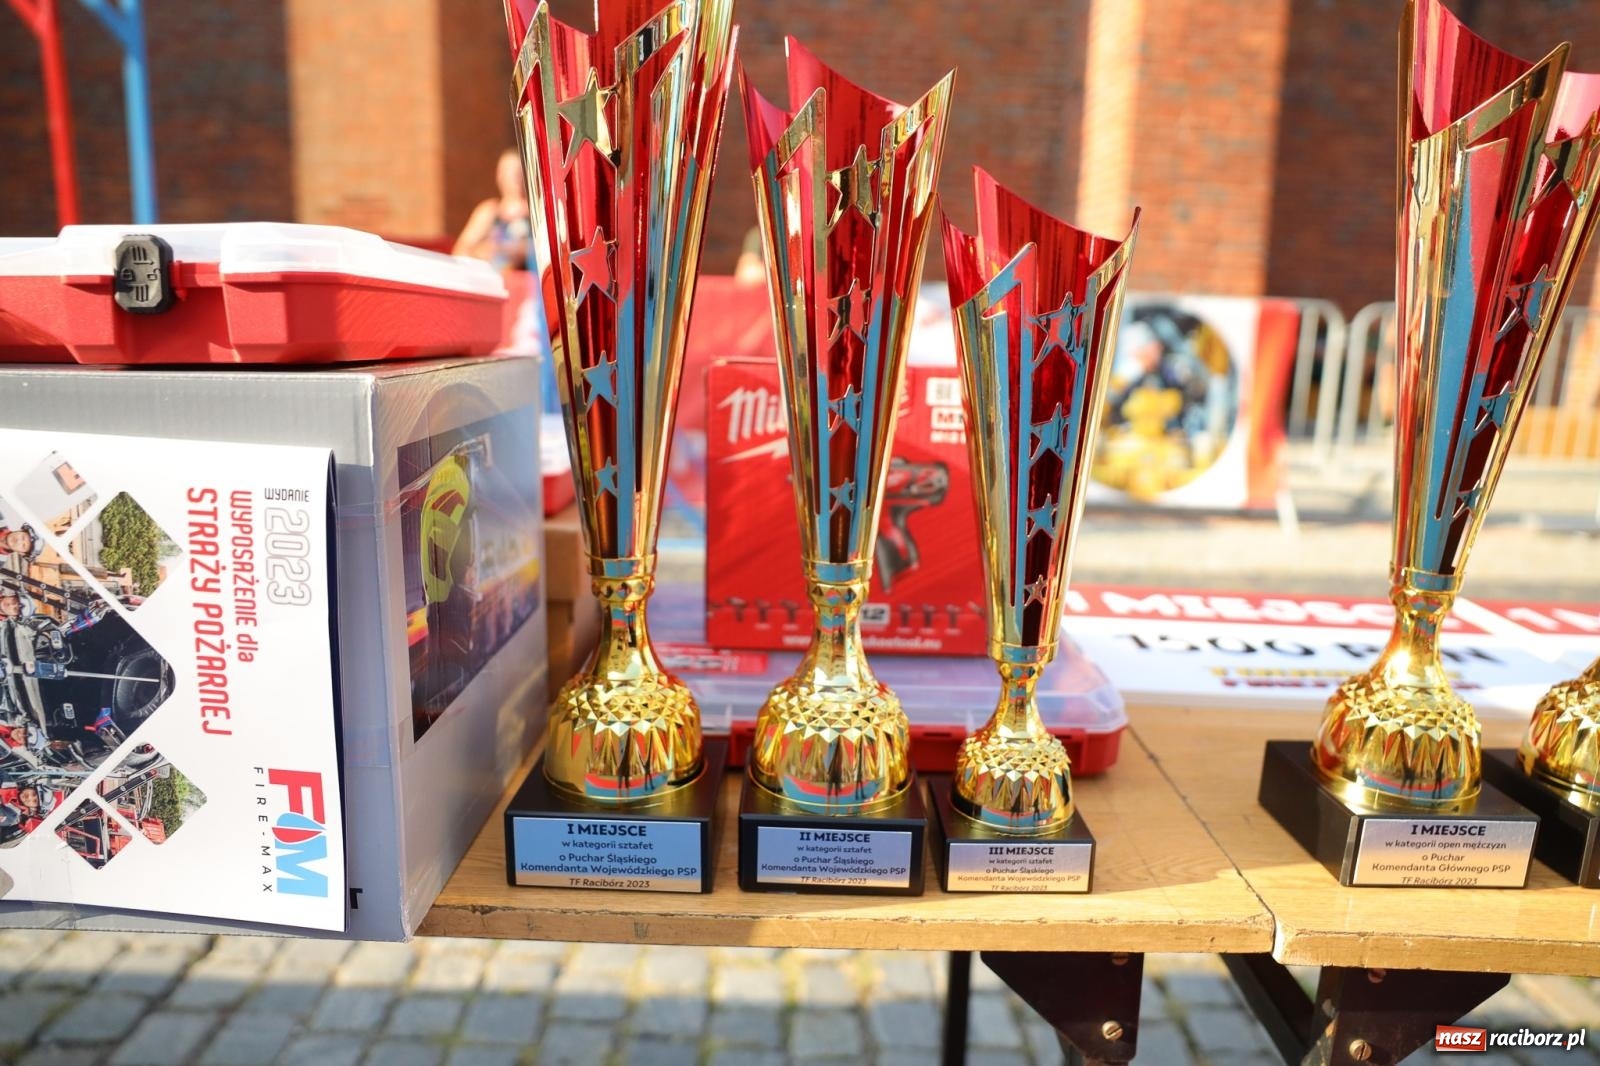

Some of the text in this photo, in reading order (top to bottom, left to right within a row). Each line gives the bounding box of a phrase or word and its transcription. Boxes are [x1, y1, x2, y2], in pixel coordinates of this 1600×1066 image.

[264, 487, 312, 606] WYDANIE 2023
[187, 487, 232, 736] STRAŻY POŻARNEJ
[236, 633, 259, 663] dla
[253, 766, 273, 892] FIRE-MAX
[567, 823, 647, 836] I MIEJSCE
[1411, 825, 1486, 836] I MIEJSCE
[800, 832, 870, 843] II MIEJSCE
[573, 840, 616, 850] kategorii
[618, 841, 653, 850] sztafet
[806, 845, 842, 853] kategorii
[1395, 840, 1436, 848] kategorii
[1463, 841, 1506, 850] mężczyzn
[989, 847, 1054, 855] III MIEJSCE
[569, 853, 604, 862] Puchar
[607, 853, 657, 865] Śląskiego
[802, 856, 830, 864] Puchar
[833, 856, 874, 866] Śląskiego
[1431, 853, 1465, 862] Puchar
[521, 863, 697, 877] Komendanta Wojewódzkiego PSP
[819, 866, 888, 875] Wojewódzkiego
[1372, 863, 1436, 871] Komendanta
[1439, 864, 1489, 874] Głównego
[583, 879, 624, 887] Racibórz
[627, 880, 650, 888] 2023
